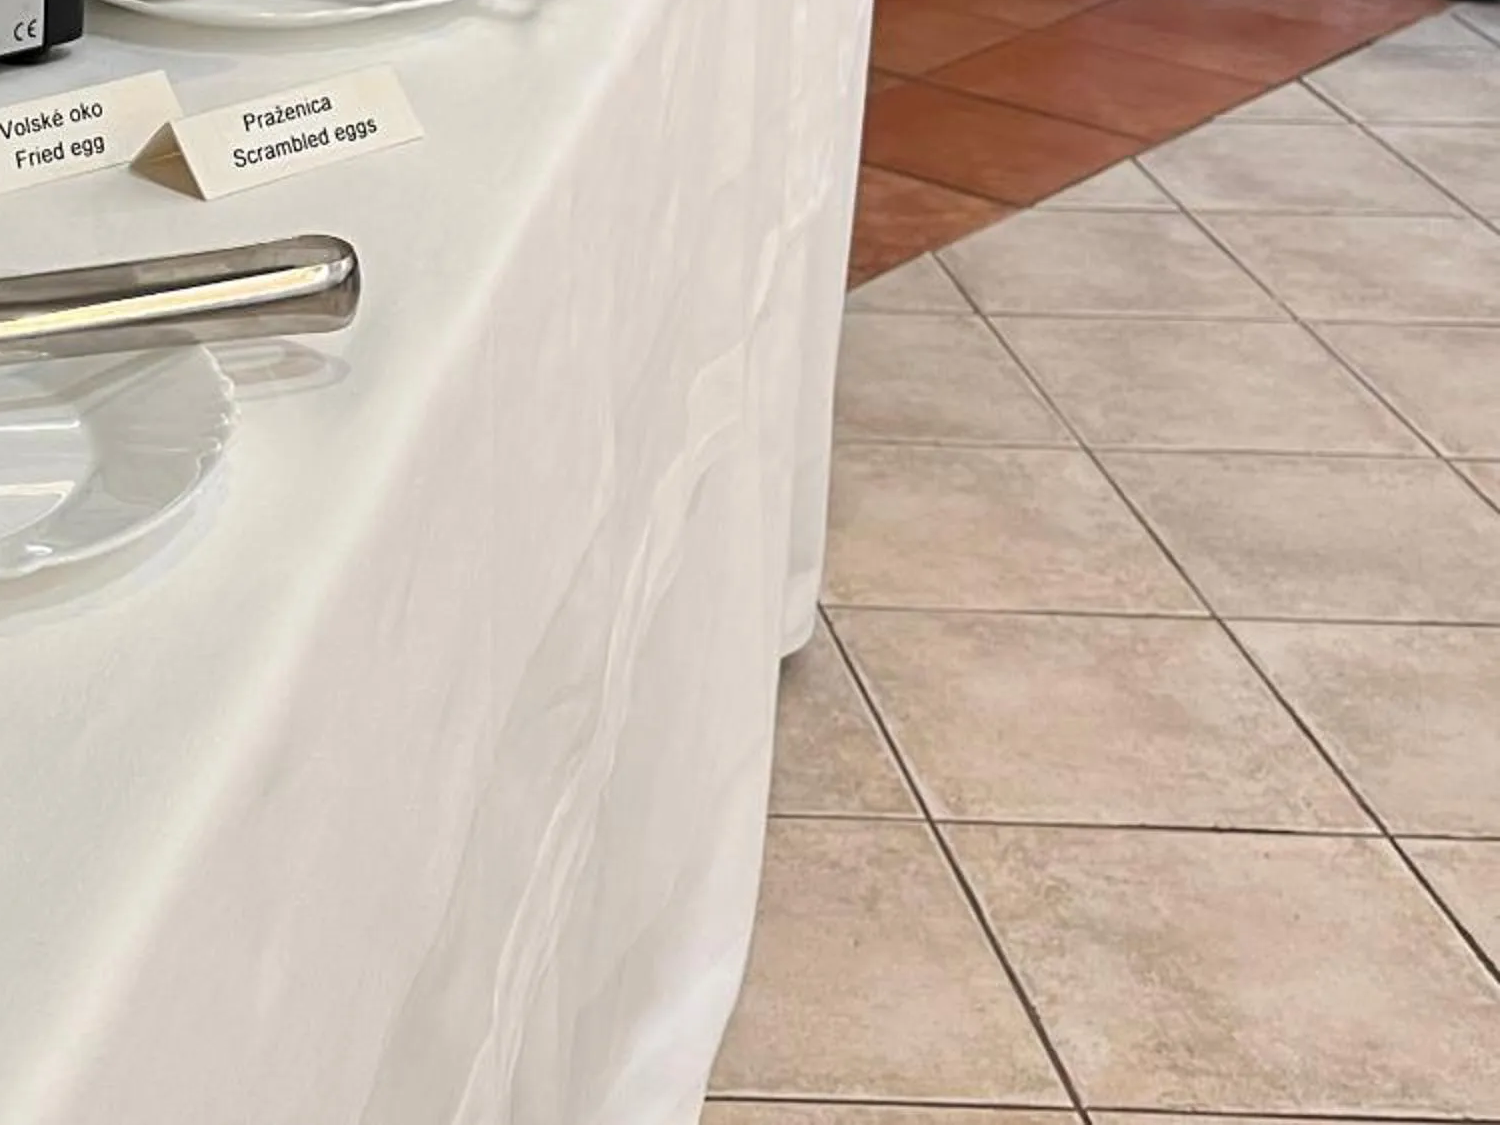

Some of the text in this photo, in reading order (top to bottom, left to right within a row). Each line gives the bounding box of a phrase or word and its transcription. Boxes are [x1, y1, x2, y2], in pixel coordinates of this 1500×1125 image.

[69, 102, 104, 122] oko
[243, 95, 333, 132] Praženica
[15, 135, 106, 169] Fried egg
[232, 117, 378, 168] Scrambled eggs
